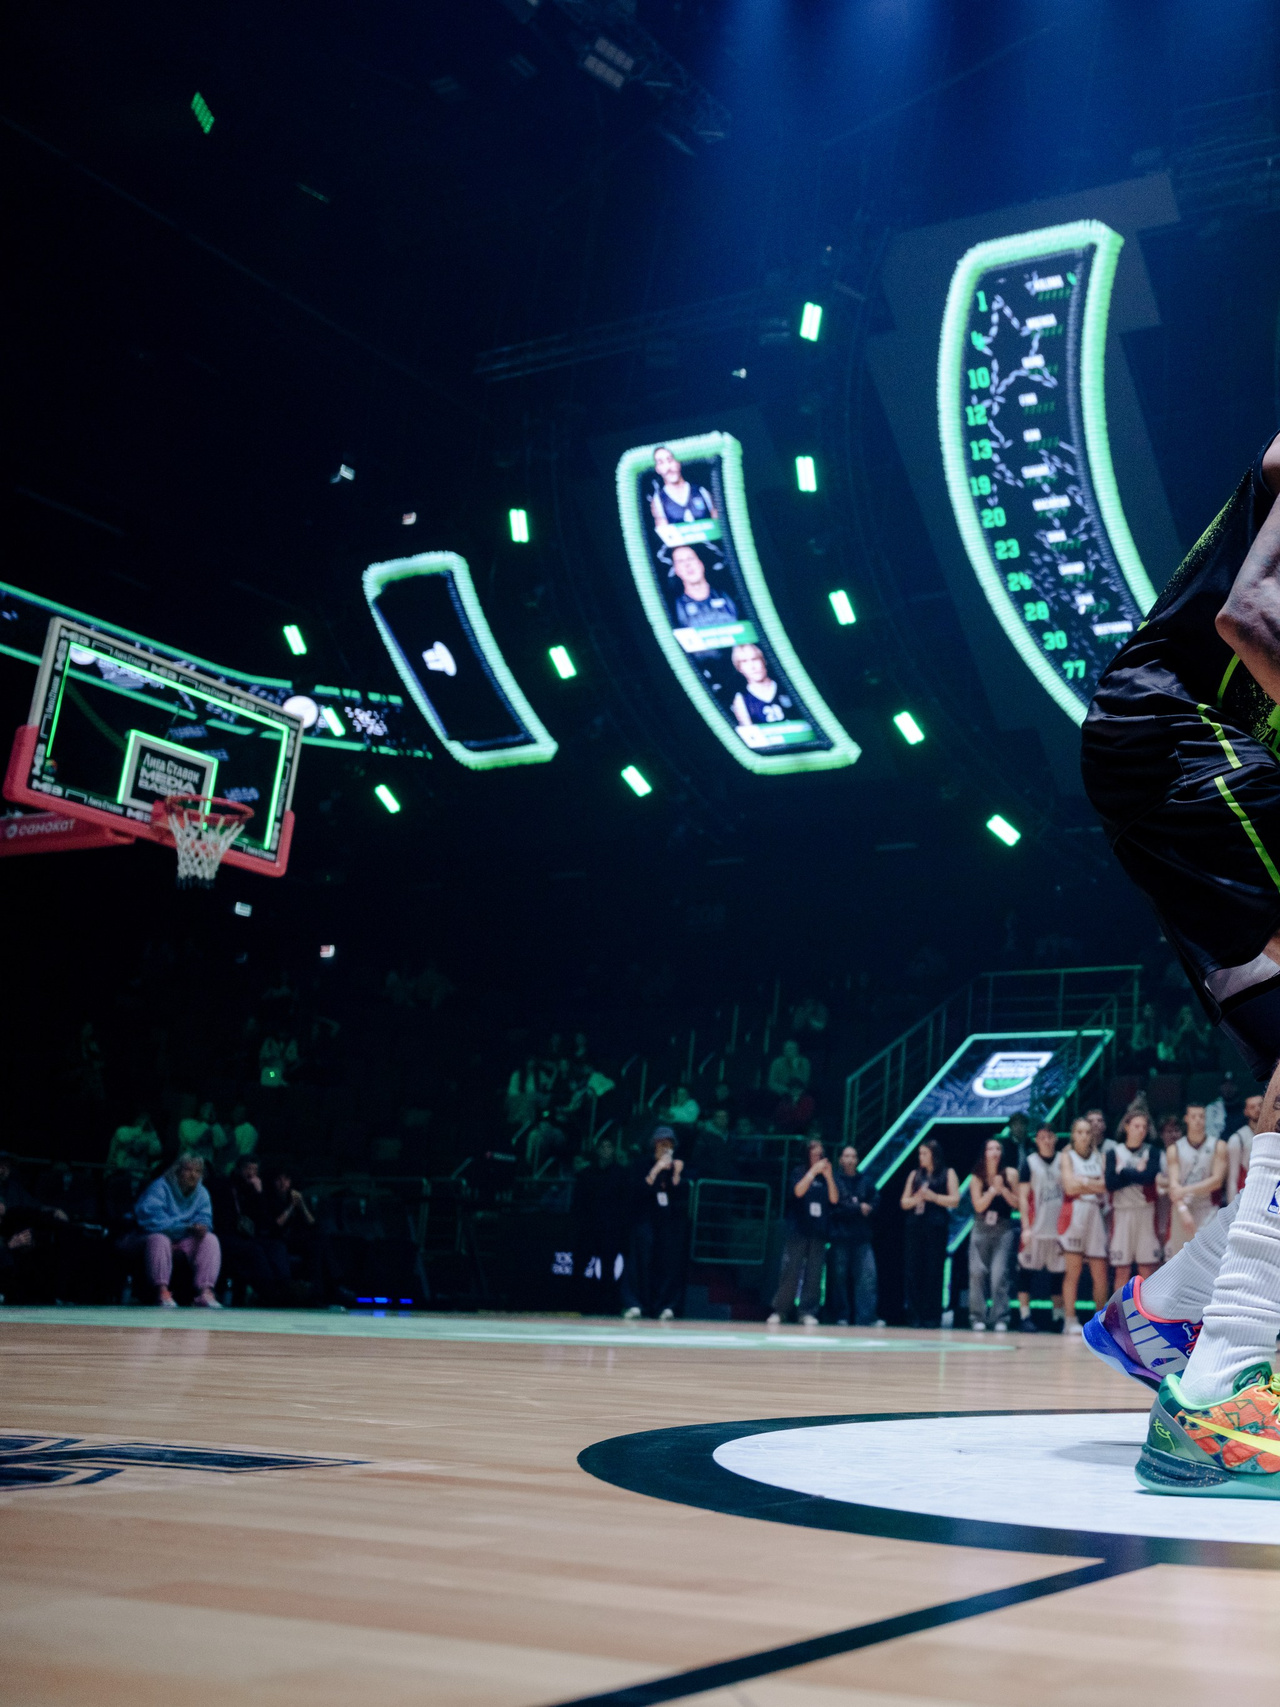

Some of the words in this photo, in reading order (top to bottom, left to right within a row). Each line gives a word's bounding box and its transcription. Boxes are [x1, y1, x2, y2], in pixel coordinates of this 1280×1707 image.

[968, 367, 990, 390] 10
[966, 404, 988, 426] 12
[970, 438, 992, 461] 13
[970, 475, 991, 497] 19
[981, 506, 1006, 529] 20
[994, 538, 1020, 560] 23
[1042, 630, 1067, 650] 30
[1062, 659, 1086, 679] 77
